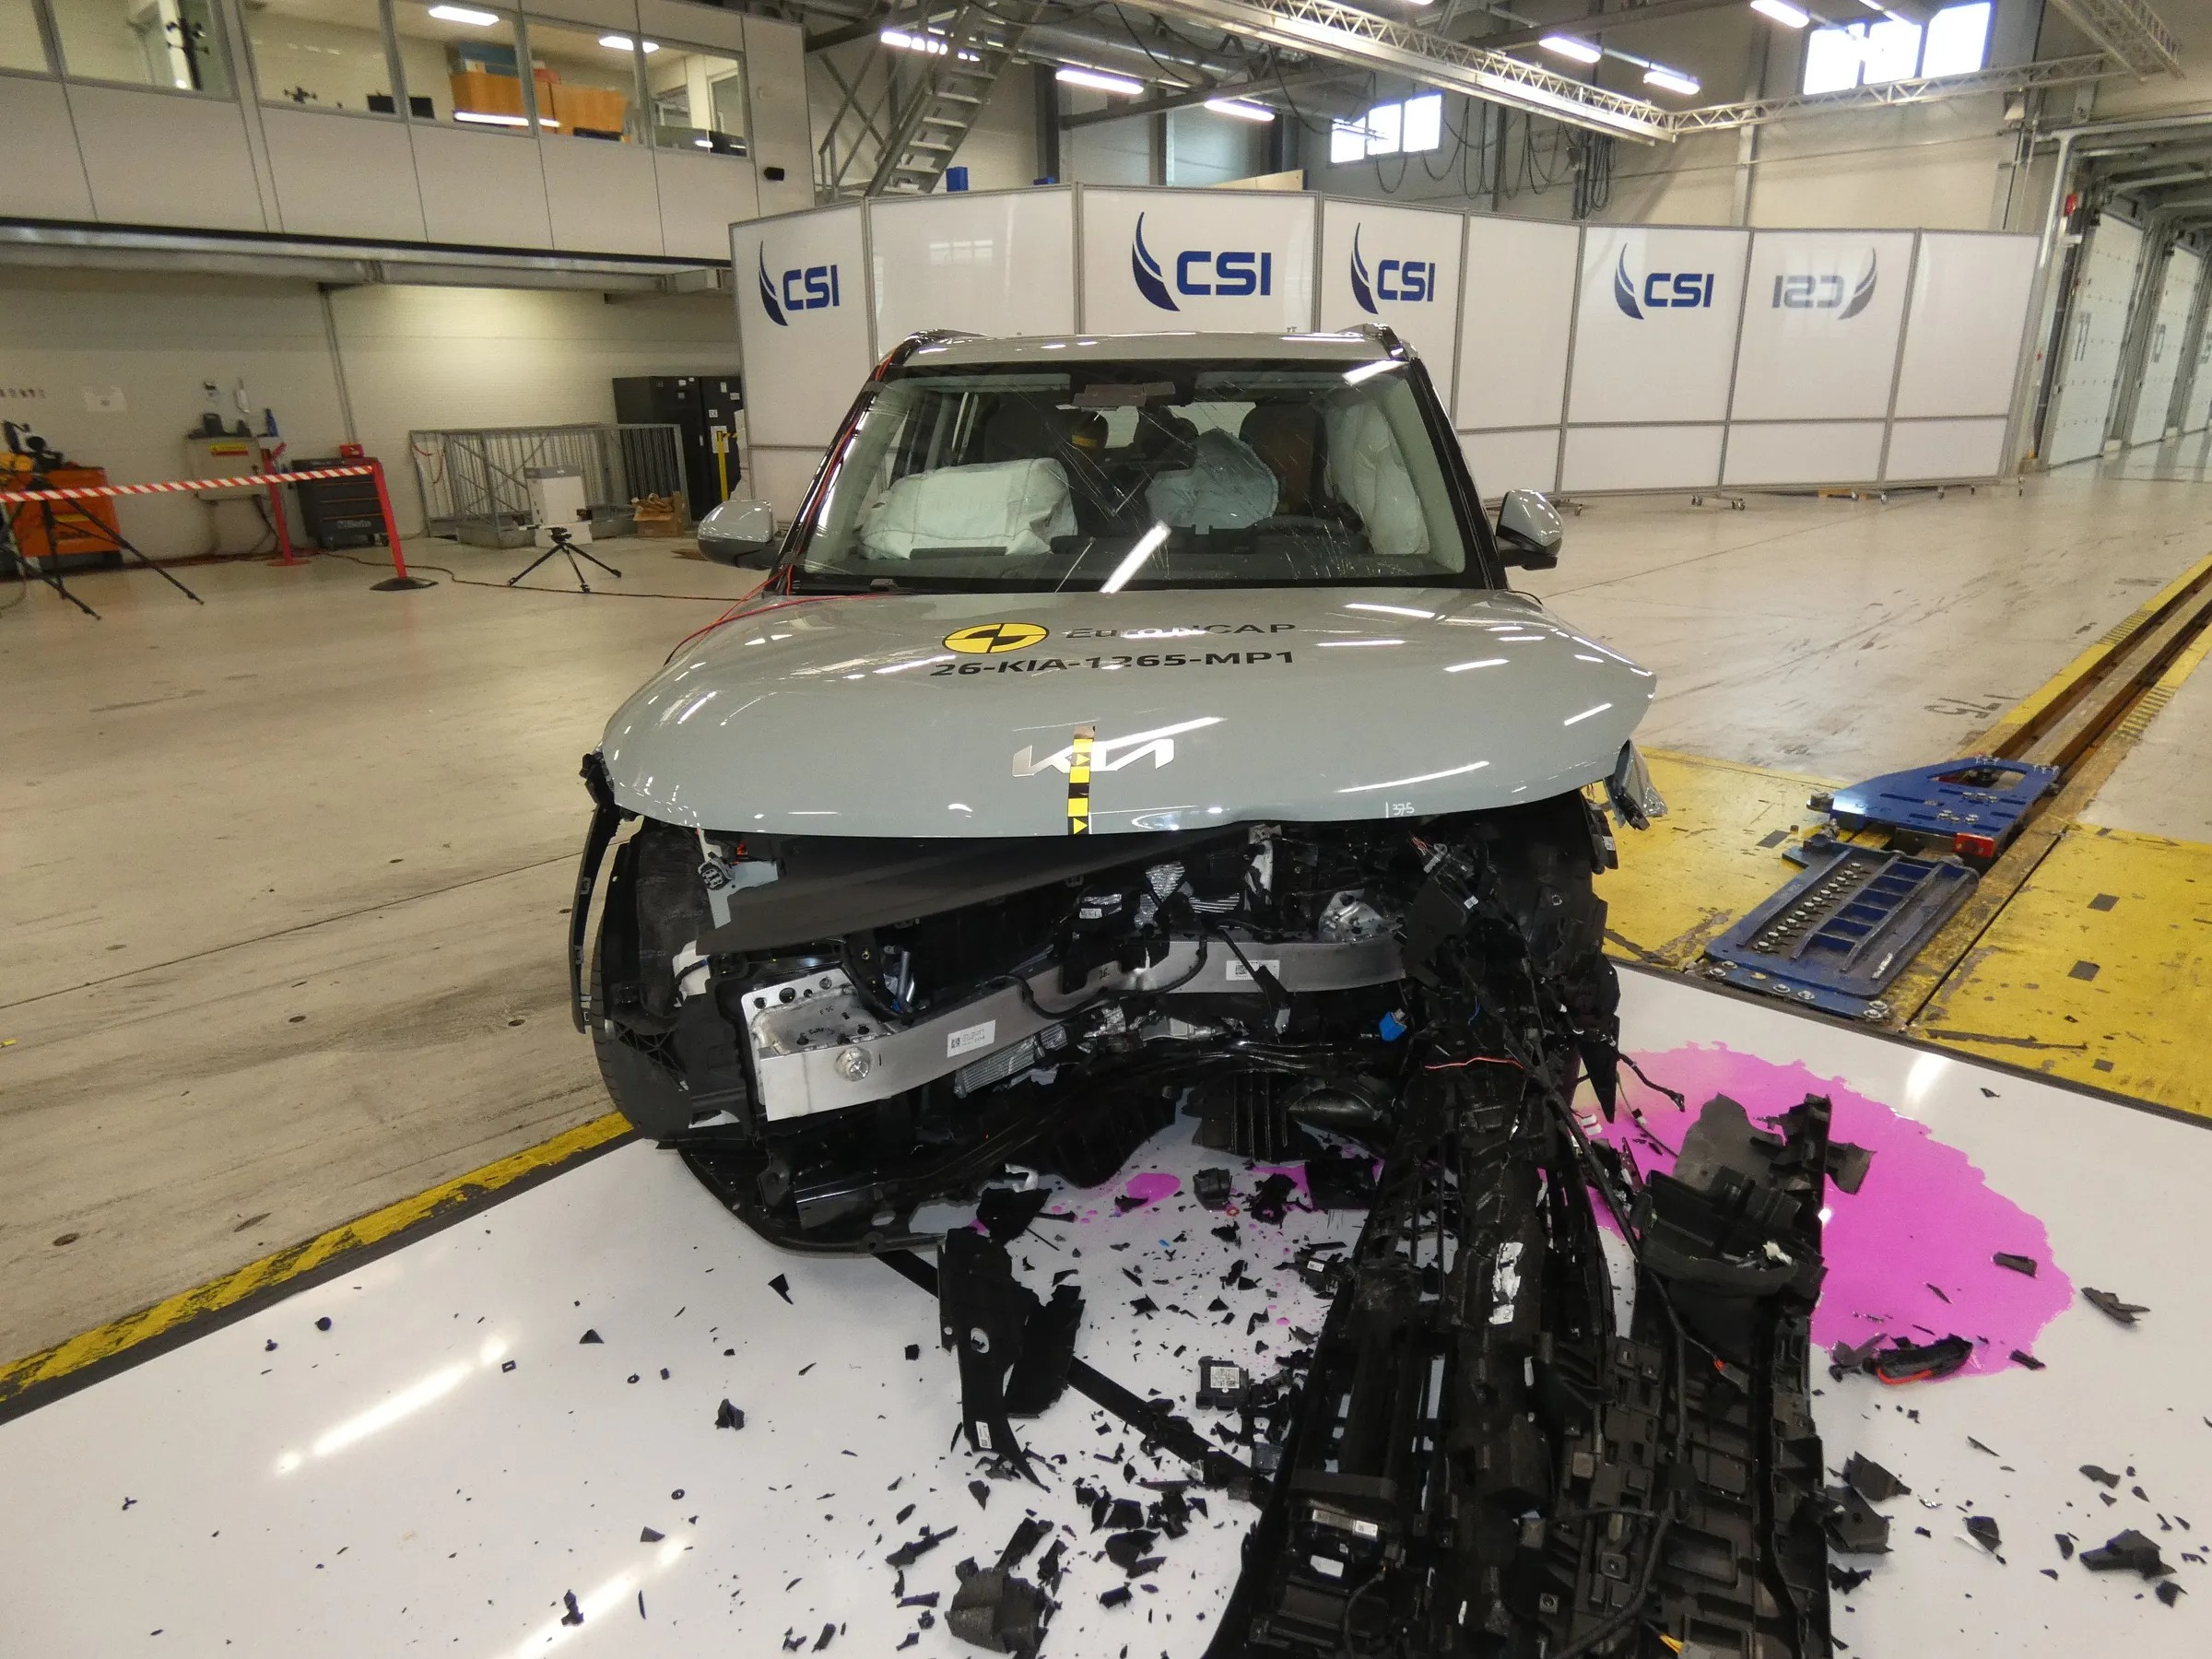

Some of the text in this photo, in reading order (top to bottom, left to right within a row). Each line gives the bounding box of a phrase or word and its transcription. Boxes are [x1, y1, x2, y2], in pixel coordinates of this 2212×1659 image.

[782, 265, 840, 311] CSI
[1177, 251, 1271, 295] CSI
[1377, 259, 1435, 301] CSI
[1644, 273, 1714, 307] CSI
[930, 651, 1293, 676] 26-KIA-1265-MP1
